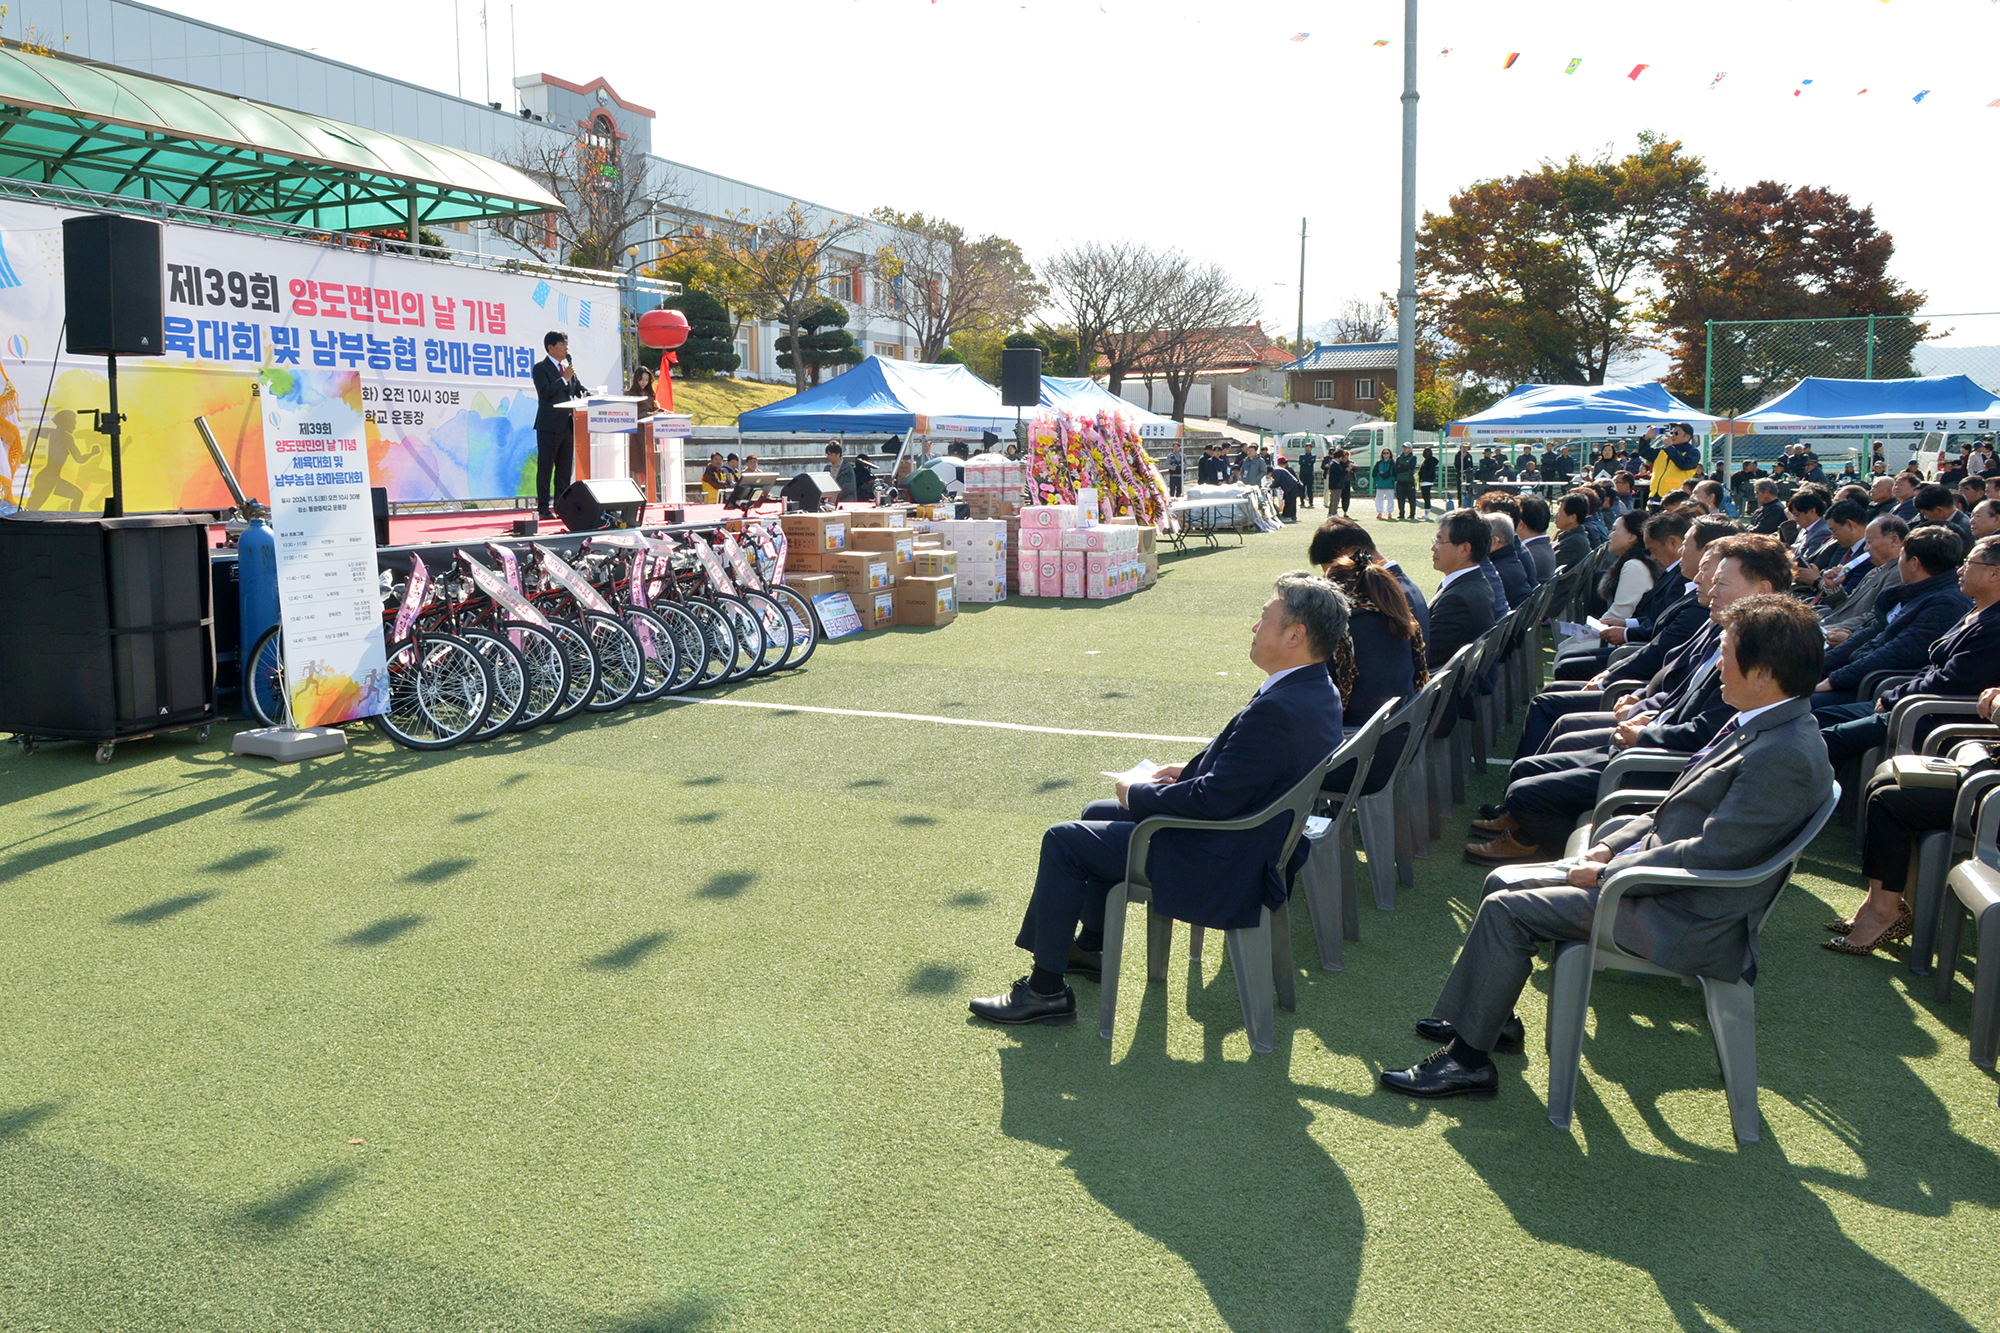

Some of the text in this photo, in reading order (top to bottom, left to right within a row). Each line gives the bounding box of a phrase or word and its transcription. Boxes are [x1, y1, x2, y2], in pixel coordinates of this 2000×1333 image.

[167, 263, 506, 335] 제39회 양도면민의 날 기념
[270, 325, 300, 365] 및
[309, 329, 417, 372] 남부농협
[424, 338, 535, 379] 한마음대회
[382, 387, 404, 403] 오전
[408, 389, 432, 404] 10시
[434, 390, 460, 405] 30분
[391, 410, 424, 426] 운동장
[299, 422, 332, 435] 제39회
[275, 438, 357, 453] 양도면민의 날 기념
[292, 455, 343, 469] 체육대회 및
[274, 471, 364, 487] 남부농협 한마음대회
